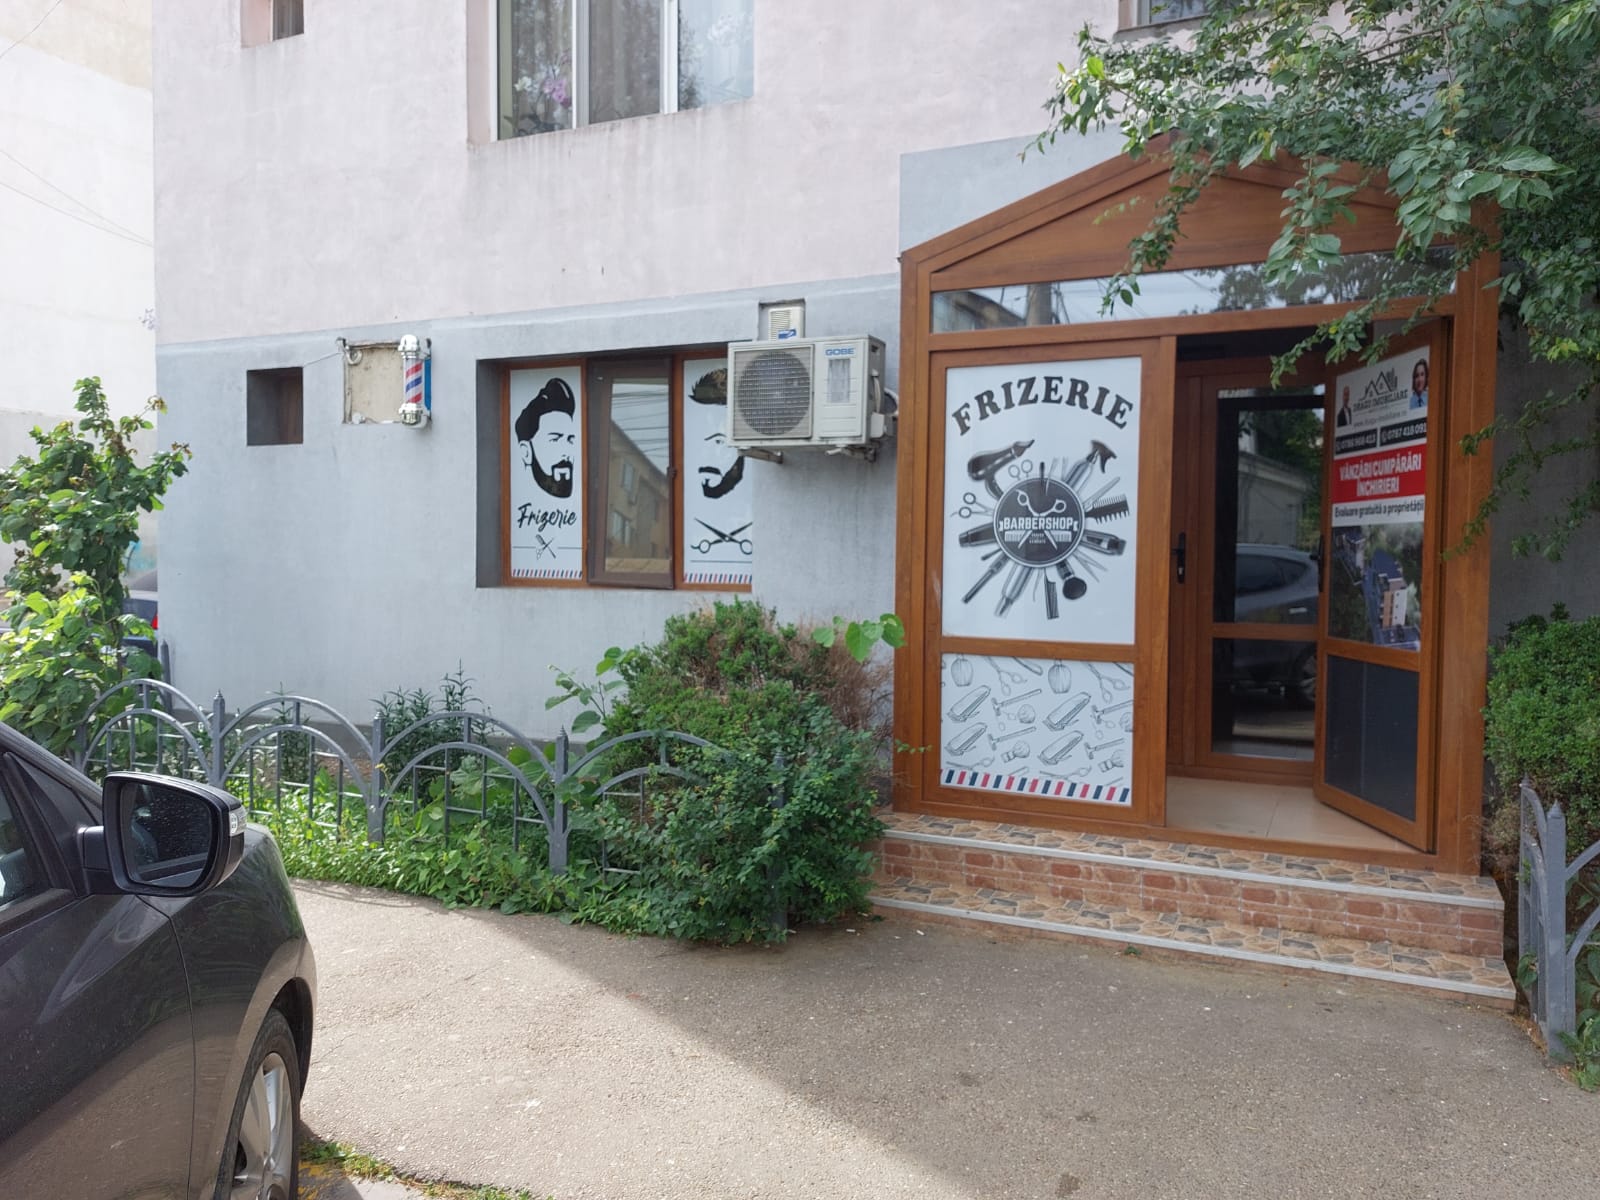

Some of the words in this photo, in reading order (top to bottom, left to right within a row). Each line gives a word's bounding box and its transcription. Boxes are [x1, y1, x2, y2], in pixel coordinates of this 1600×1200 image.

[825, 347, 855, 356] GOBE
[952, 376, 1133, 436] FRIZERIE
[518, 503, 577, 532] Frizerie
[1004, 517, 1074, 530] BARBERSHOP
